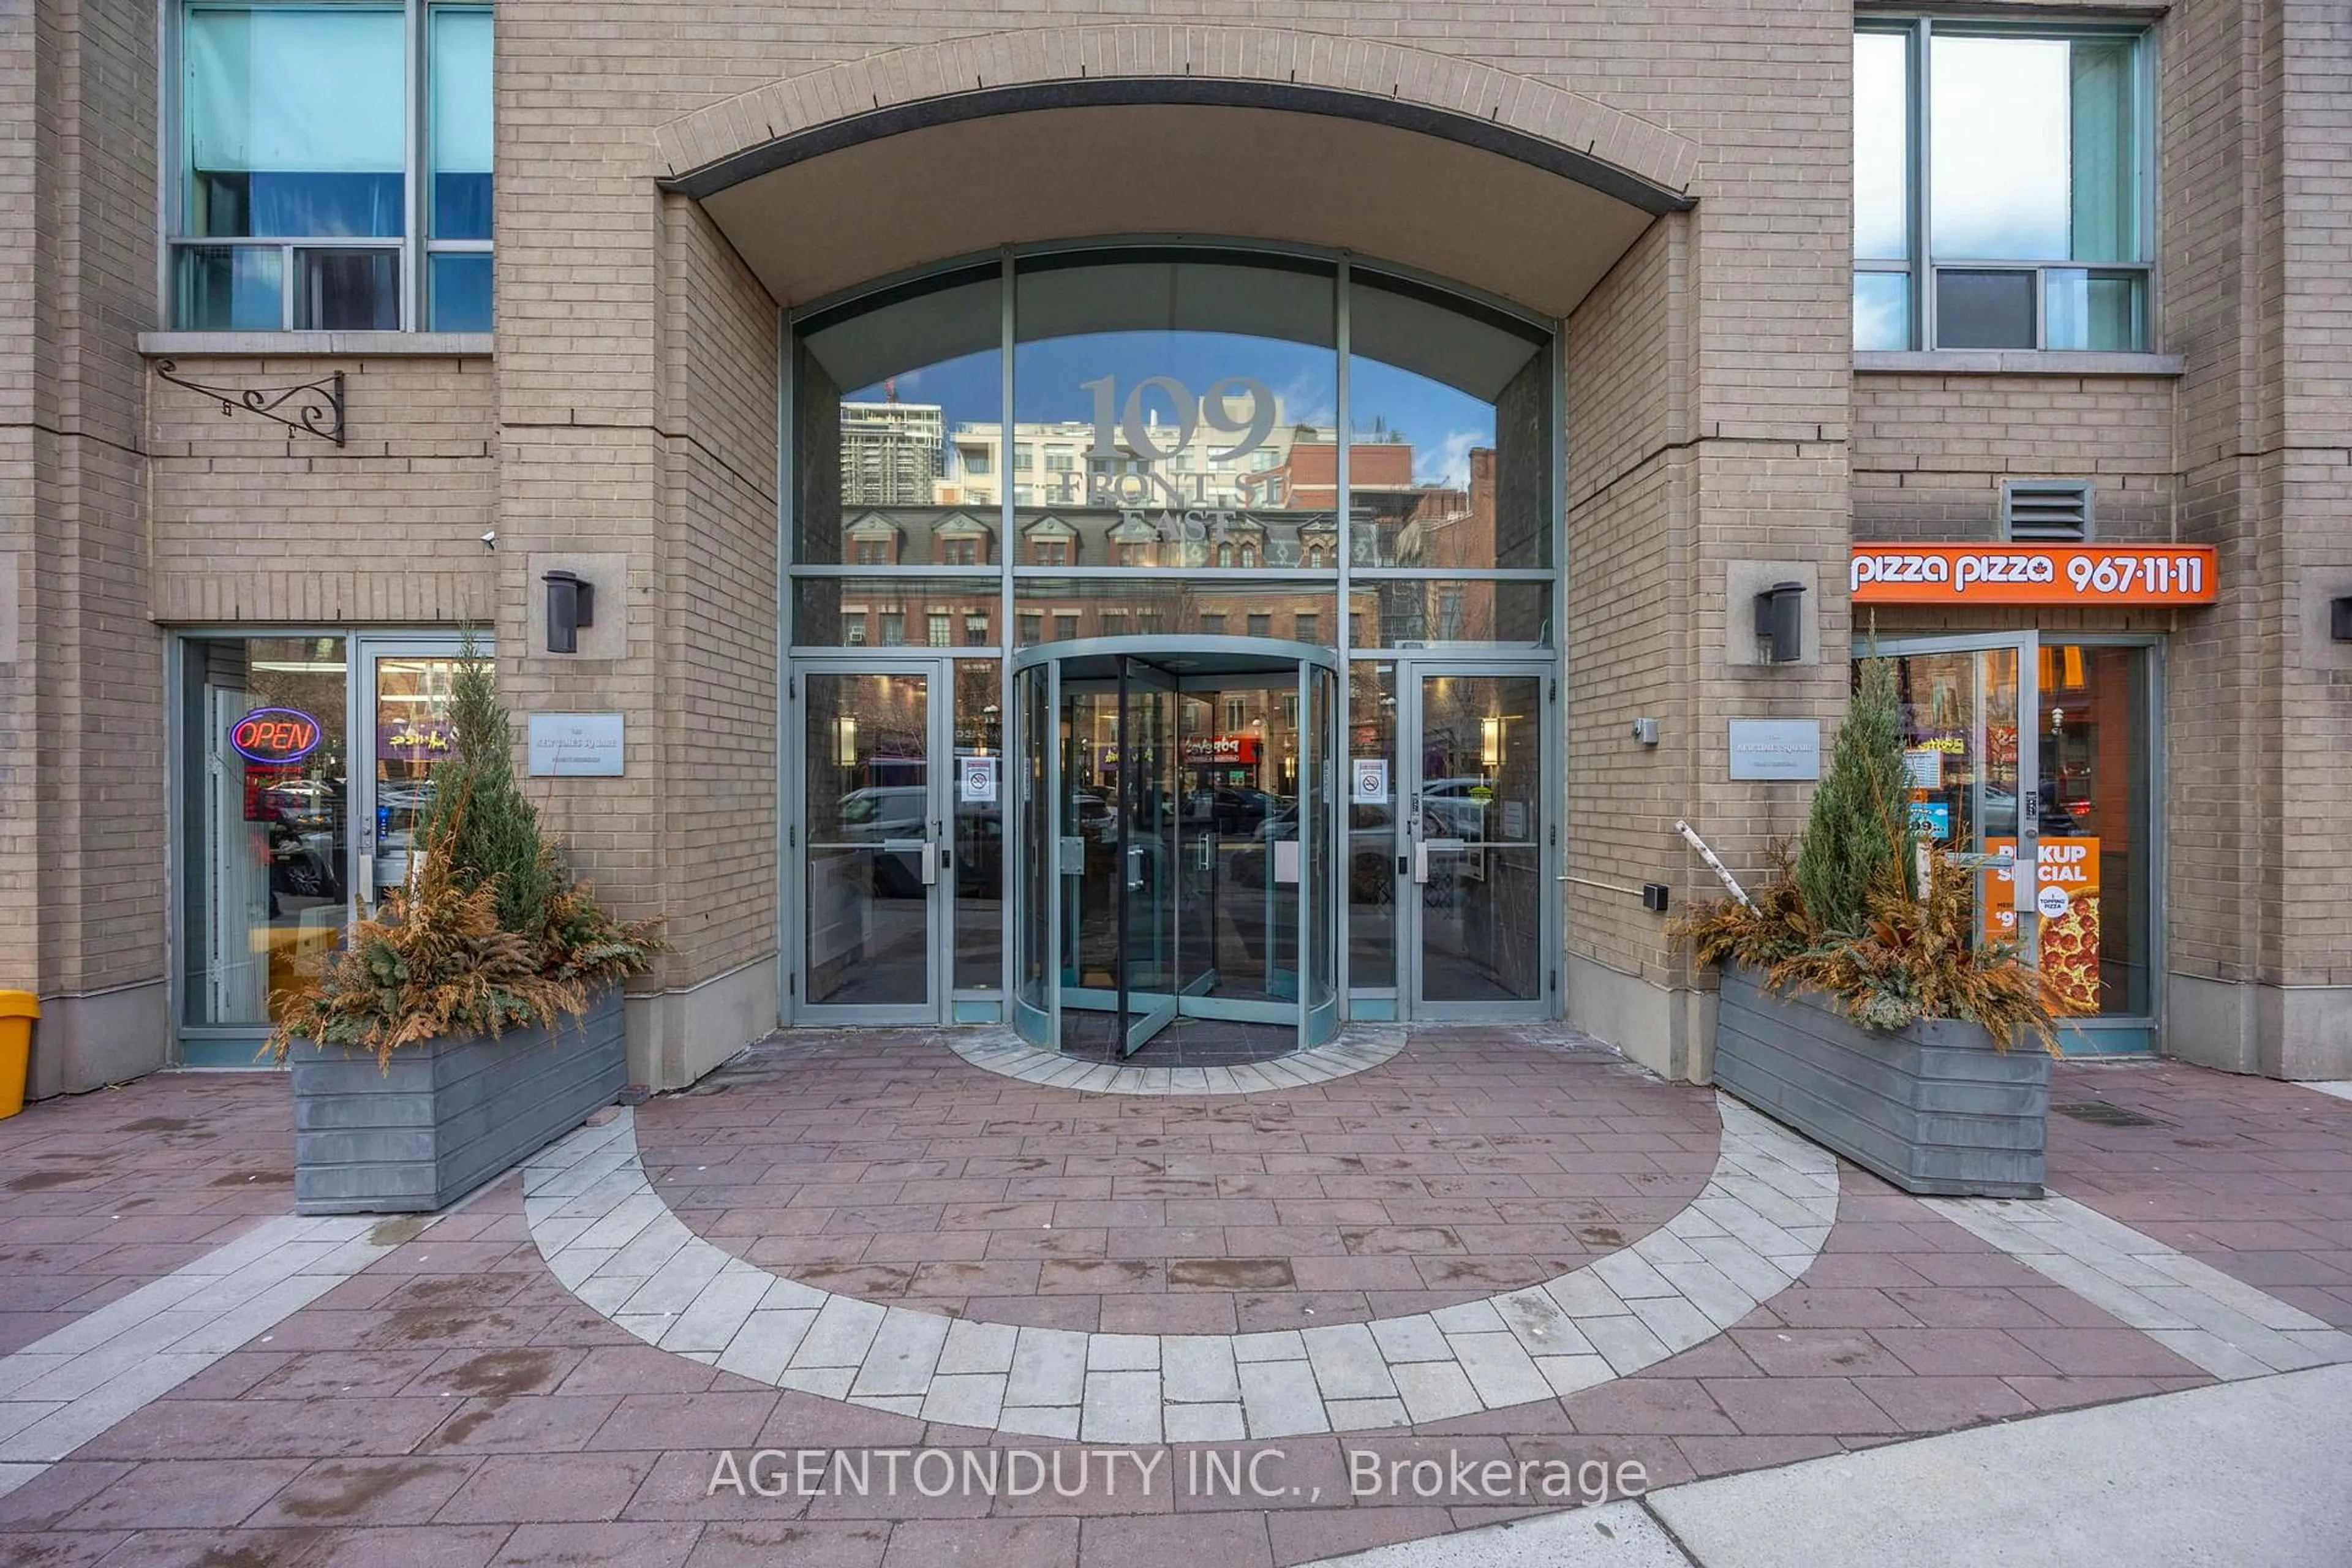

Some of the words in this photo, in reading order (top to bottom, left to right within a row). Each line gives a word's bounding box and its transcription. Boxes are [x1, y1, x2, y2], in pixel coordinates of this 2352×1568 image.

[1080, 373, 1276, 461] 109
[1059, 472, 1216, 508] FRONT
[1119, 510, 1238, 543] EAST
[1850, 555, 1949, 592] pizza
[1954, 554, 2054, 592] pizza
[236, 722, 312, 749] OPEN
